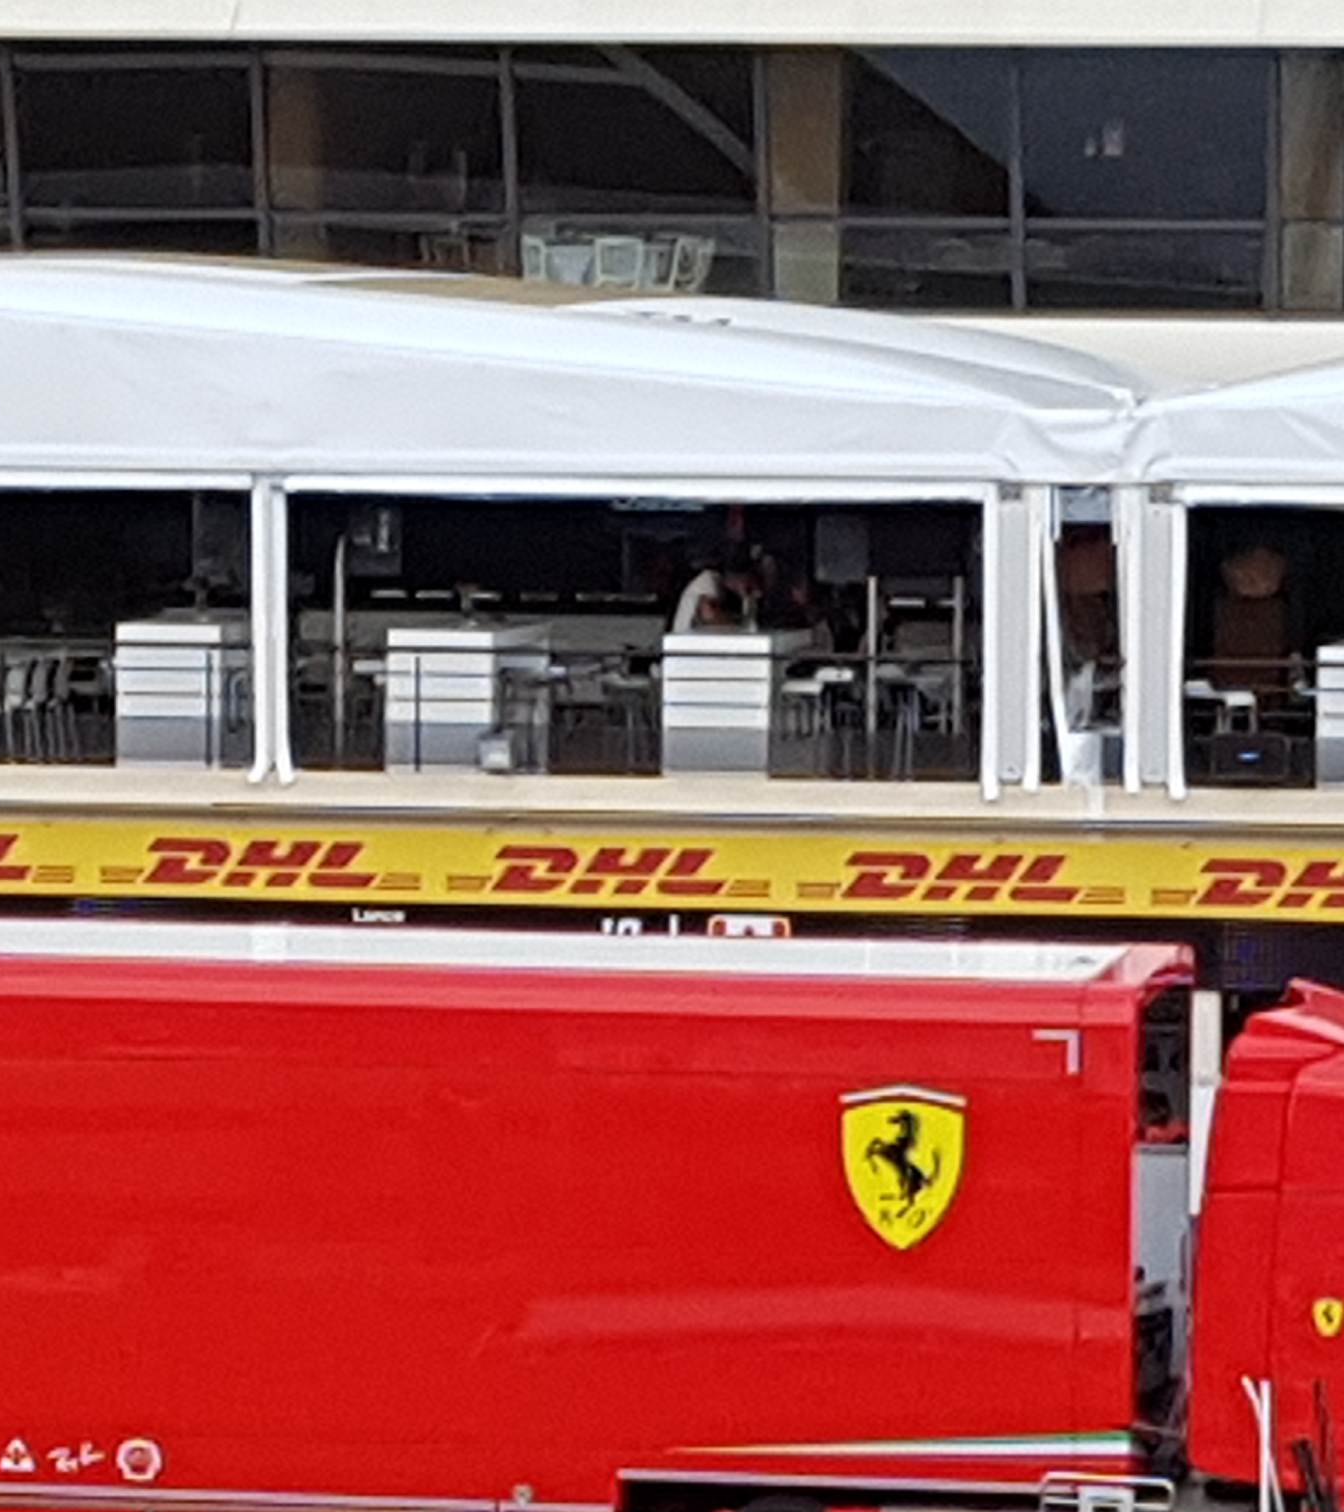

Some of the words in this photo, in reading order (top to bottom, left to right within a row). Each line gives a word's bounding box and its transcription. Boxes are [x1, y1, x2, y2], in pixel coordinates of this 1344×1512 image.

[146, 838, 377, 888] DHL
[492, 846, 726, 895] DHL
[844, 852, 1080, 902] DHL
